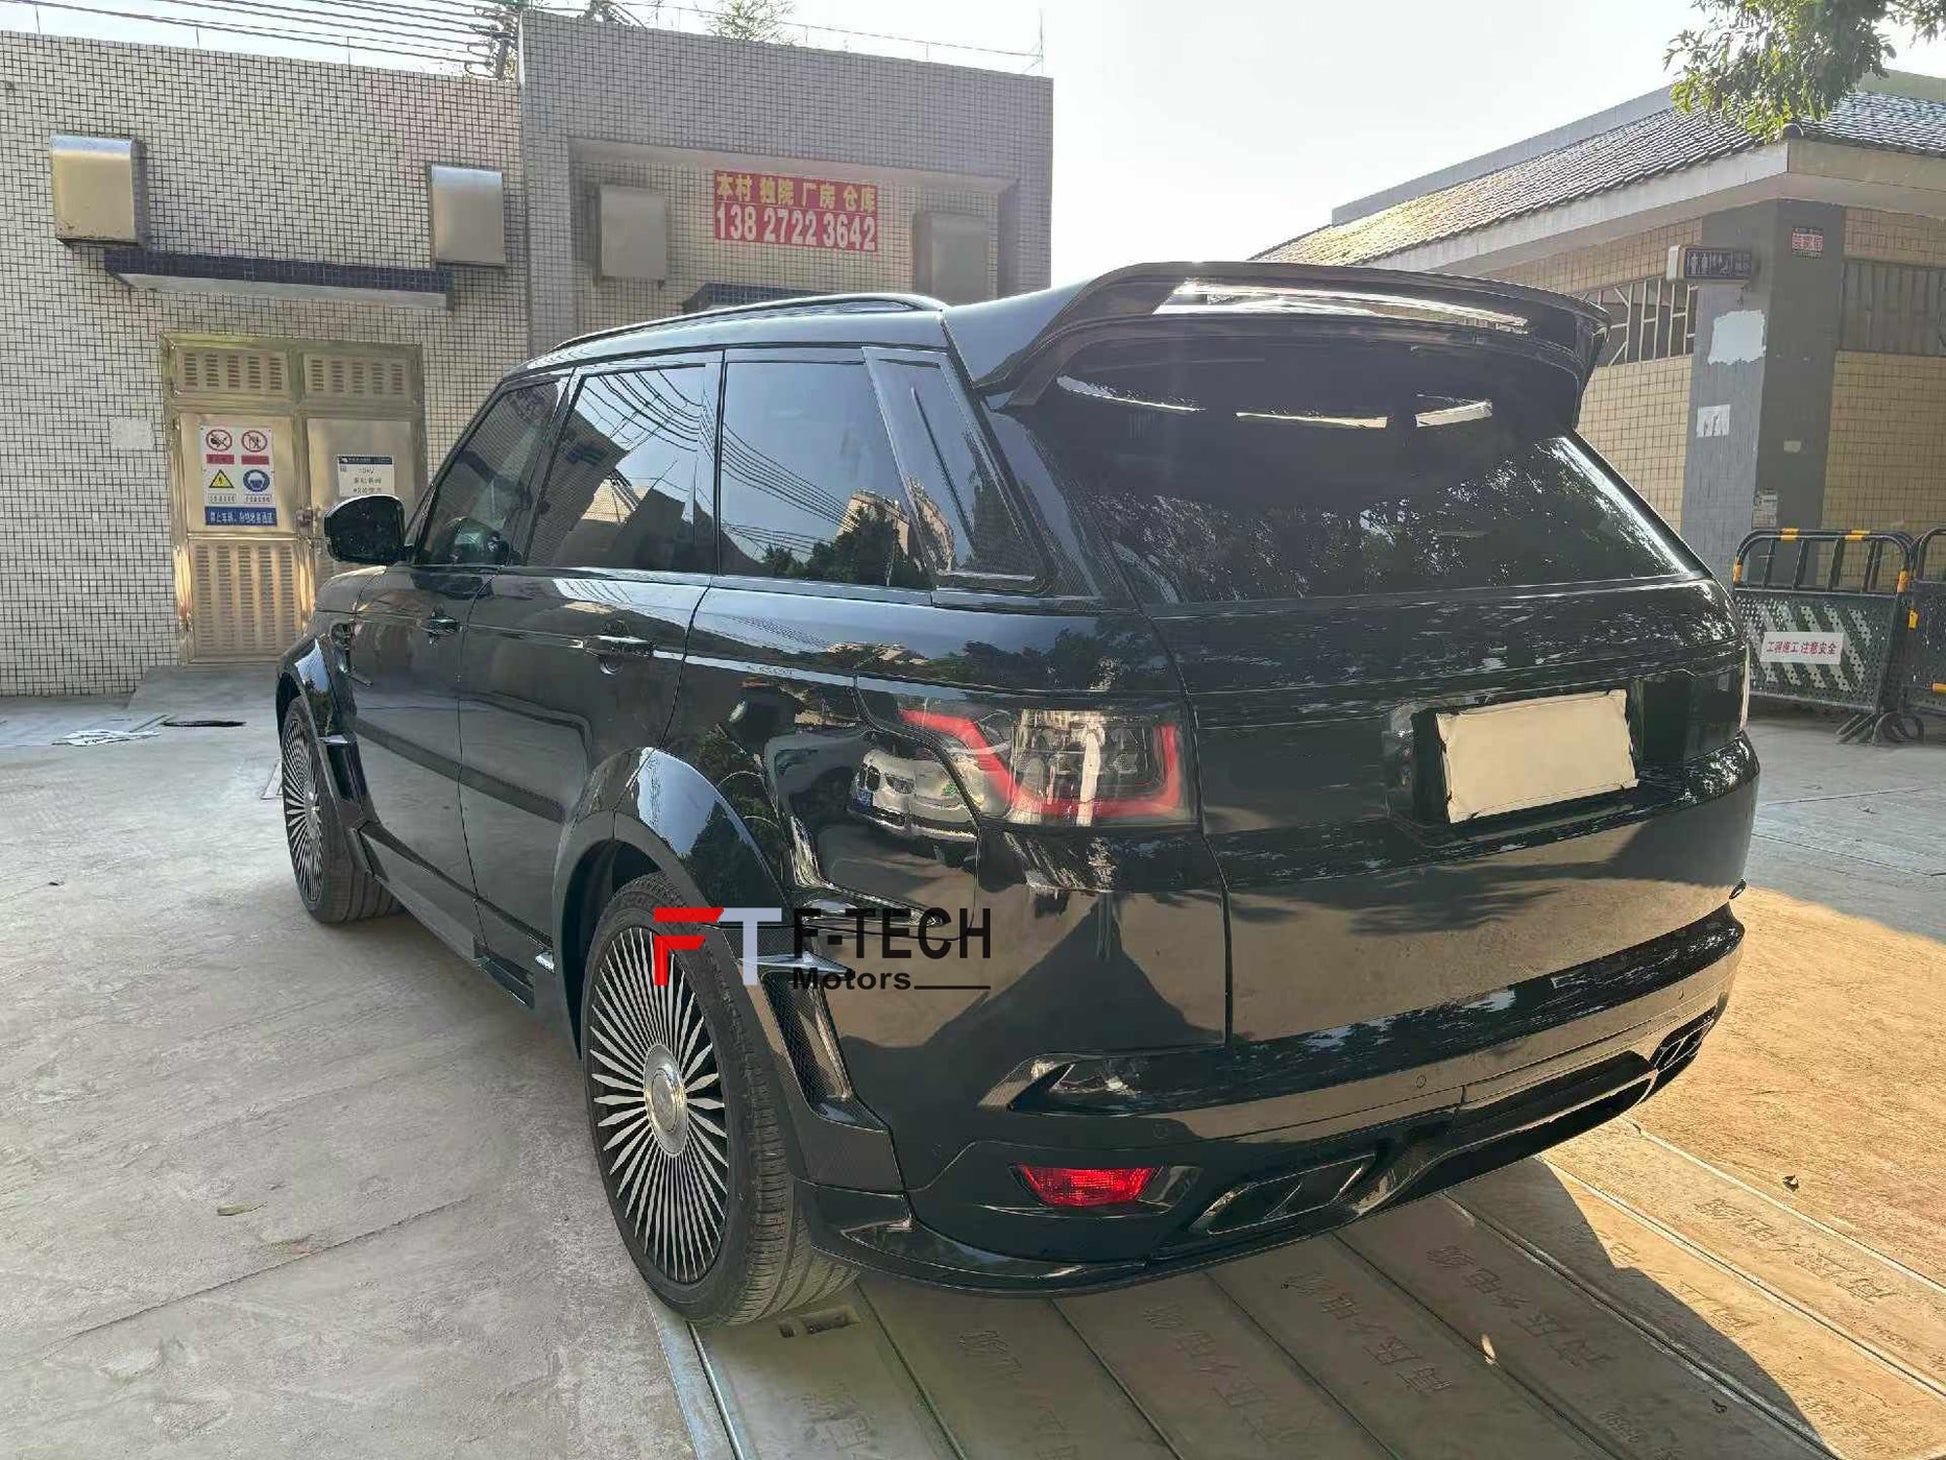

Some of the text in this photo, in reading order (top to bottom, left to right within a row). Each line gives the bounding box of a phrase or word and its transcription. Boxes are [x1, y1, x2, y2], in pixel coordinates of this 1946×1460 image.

[717, 173, 752, 201] 本村
[843, 185, 875, 212] 仓库
[717, 202, 876, 250] 138 2722 3642
